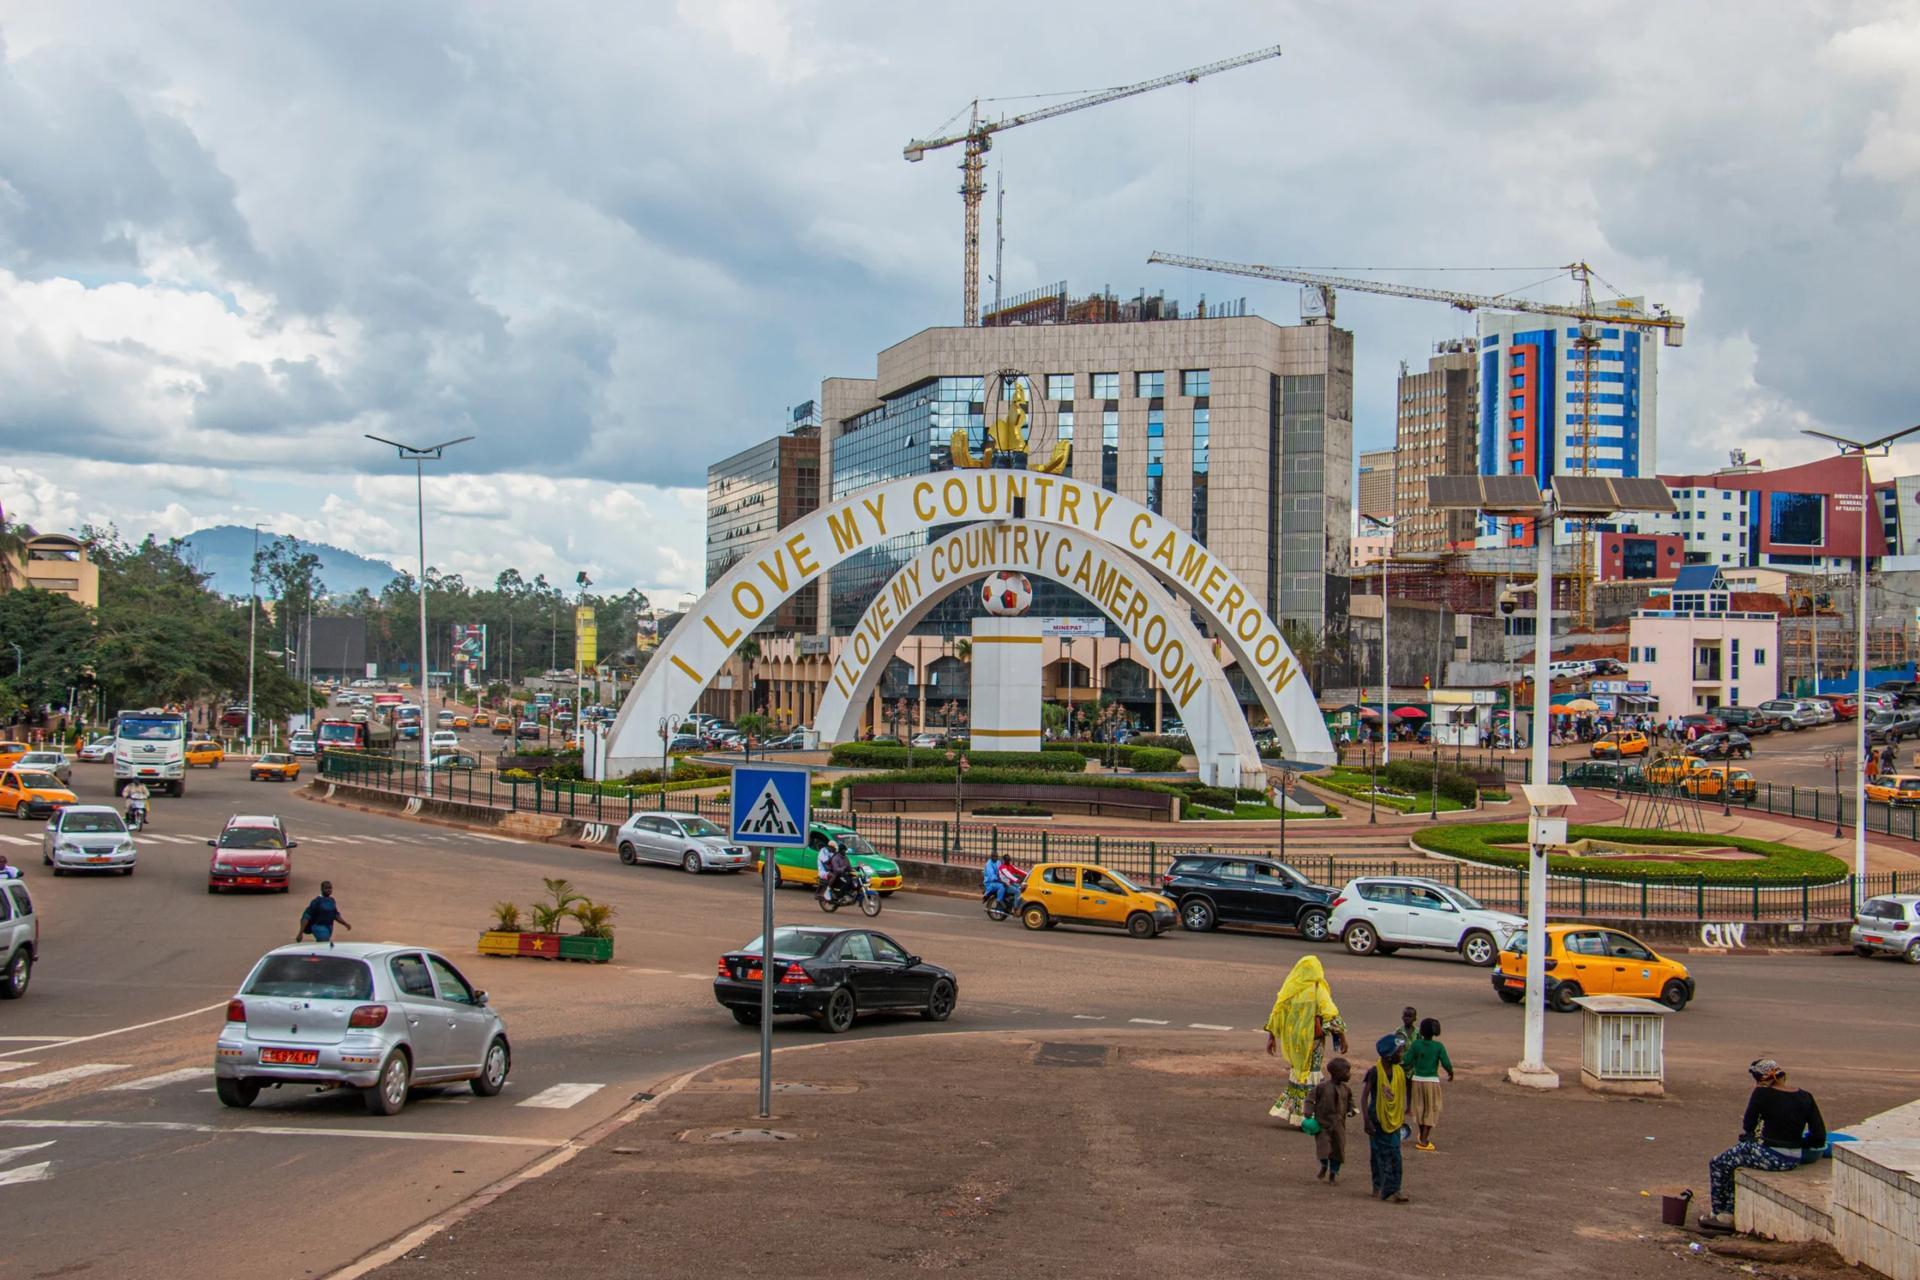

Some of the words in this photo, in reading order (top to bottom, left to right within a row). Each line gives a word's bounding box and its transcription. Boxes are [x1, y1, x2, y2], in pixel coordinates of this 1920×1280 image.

[1637, 325, 1653, 333] ACC
[931, 524, 1050, 583] COUNTRY
[671, 655, 703, 683] I
[703, 532, 820, 648] LOVE
[827, 493, 887, 554] MY
[913, 474, 1113, 531] COUNTRY
[1130, 513, 1297, 694] CAMEROON
[891, 559, 923, 616] MY
[841, 594, 895, 687] LOVE
[1054, 537, 1203, 709] CAMEROON
[834, 675, 849, 700] I
[1701, 922, 1746, 948] CUY
